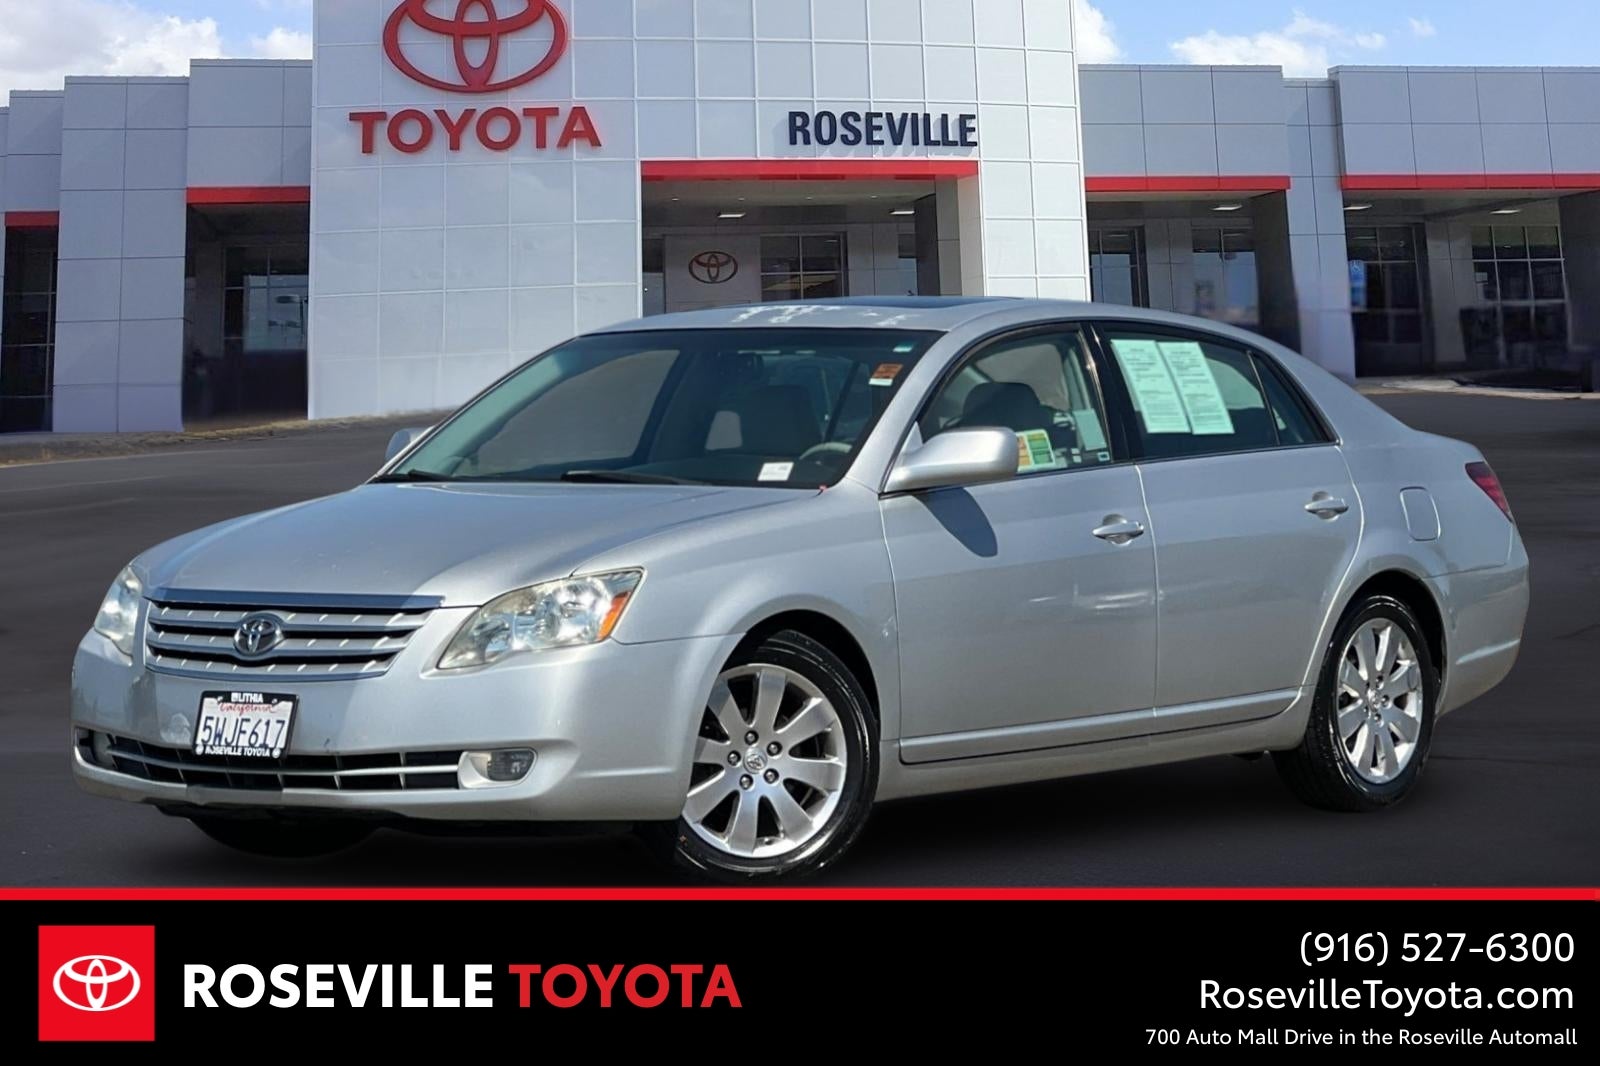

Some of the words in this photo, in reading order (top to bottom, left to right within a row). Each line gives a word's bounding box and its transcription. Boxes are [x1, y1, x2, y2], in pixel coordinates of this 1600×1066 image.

[349, 106, 602, 154] TOYOTA
[788, 110, 978, 147] ROSEVILLE
[239, 692, 263, 703] LITHIA
[201, 715, 286, 749] 5WJF617
[205, 745, 242, 756] ROSEVILLE
[243, 747, 271, 757] TOYOTA
